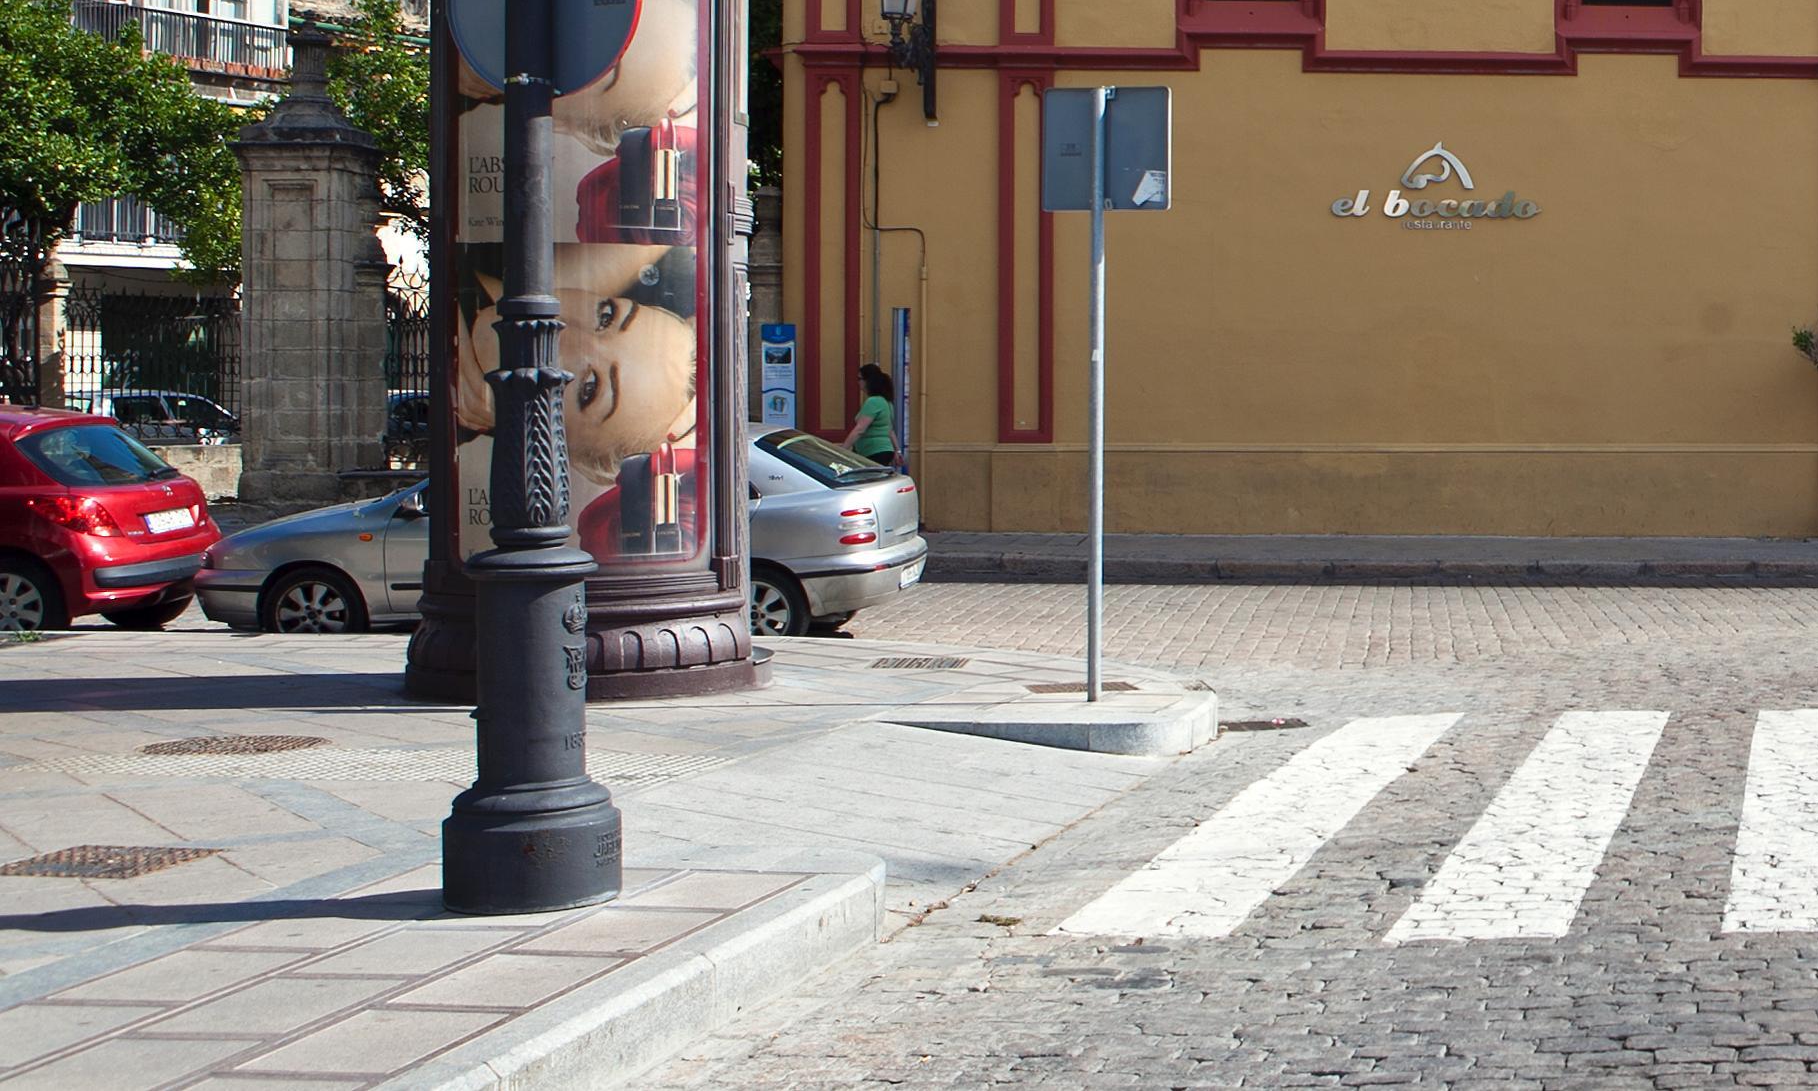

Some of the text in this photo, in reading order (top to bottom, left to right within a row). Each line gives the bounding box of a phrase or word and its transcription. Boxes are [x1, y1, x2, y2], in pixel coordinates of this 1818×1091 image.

[1330, 190, 1542, 219] el bocado
[1401, 219, 1472, 230] restaurante
